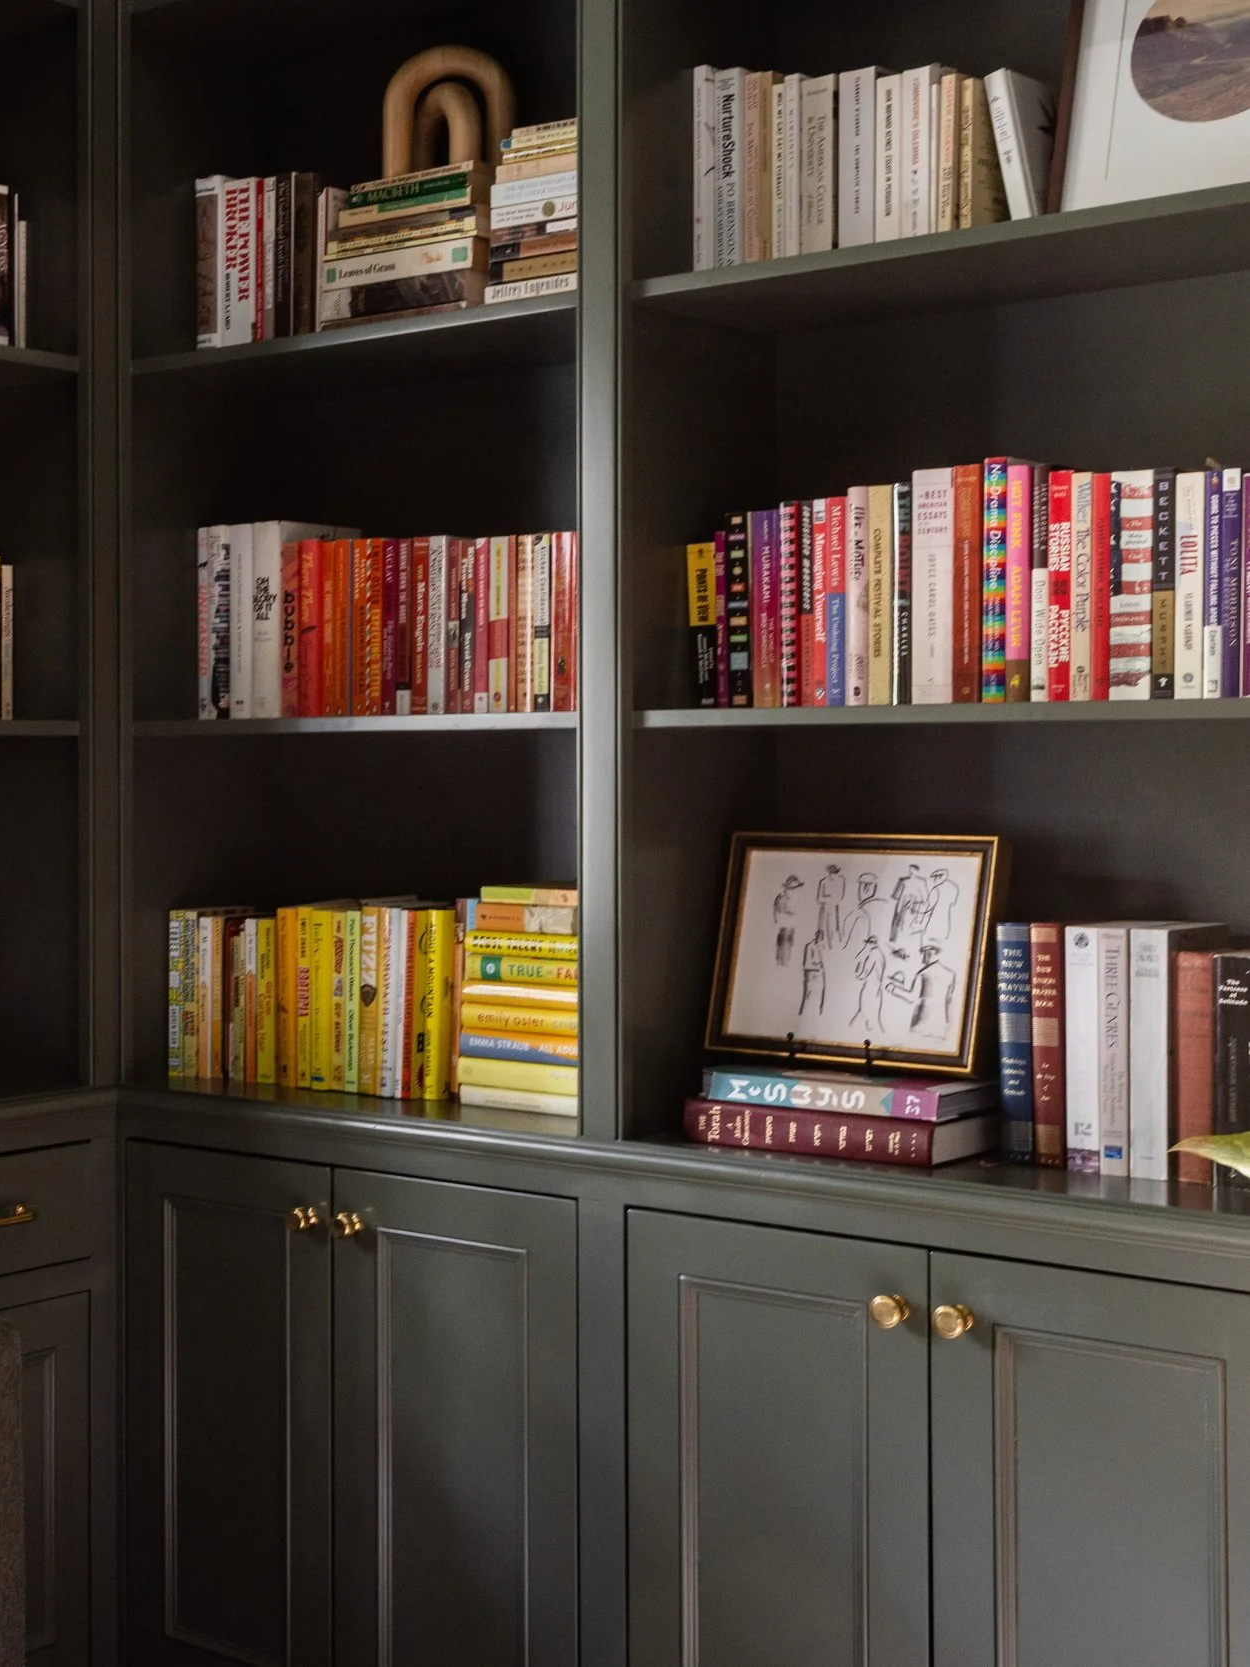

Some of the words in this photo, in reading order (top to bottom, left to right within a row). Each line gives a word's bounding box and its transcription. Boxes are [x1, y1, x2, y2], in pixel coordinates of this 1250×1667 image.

[775, 109, 784, 120] MY
[775, 121, 784, 136] CAT
[816, 114, 827, 131] THE
[884, 103, 894, 129] MAYNARD
[721, 92, 736, 179] NurtureShock
[775, 137, 784, 151] EAT
[806, 125, 817, 177] UNIVERSITY
[853, 143, 862, 155] THE
[884, 130, 894, 152] KEYNES
[911, 129, 921, 165] DILEMMA
[775, 152, 784, 162] MY
[815, 135, 828, 183] AMERICAN
[853, 157, 862, 186] COMPLETE
[884, 154, 894, 174] ESSAYS
[238, 186, 251, 226] THE
[367, 181, 420, 201] MACBETH
[815, 185, 828, 225] COLLEGE
[884, 183, 894, 217] PERSUASION
[225, 187, 238, 272] BROKER
[724, 198, 736, 256] BRONSON
[237, 230, 251, 302] POWER
[337, 265, 363, 279] Leaves
[373, 261, 397, 274] Grass
[491, 284, 524, 300] Jeffrey
[524, 276, 570, 294] Eugenides
[989, 463, 1006, 527] No-Drama
[1011, 479, 1023, 506] HOT
[1075, 482, 1091, 524] Walker
[1209, 494, 1220, 512] GOING
[802, 505, 812, 555] invisible
[830, 504, 843, 552] Michael
[1011, 511, 1023, 549] PINK
[1158, 480, 1170, 581] BECKETT
[1209, 513, 1220, 525] TO
[873, 528, 883, 575] COMPLETE
[1049, 521, 1061, 571] STORIES
[1059, 521, 1071, 571] RUSSIAN
[1075, 528, 1091, 548] The
[1208, 526, 1220, 549] PIECES
[540, 545, 550, 575] Kitchen
[813, 532, 827, 591] Managing
[830, 553, 842, 587] Lewis
[898, 533, 911, 592] POINT
[927, 554, 937, 579] JOYCE
[988, 529, 1007, 591] Discipline
[1075, 553, 1091, 589] Color
[1179, 534, 1199, 576] LOLITA
[1208, 549, 1220, 579] WITHOUT
[1228, 538, 1239, 571] TONI
[372, 576, 381, 605] OSTER
[461, 557, 469, 592] Flower
[696, 567, 709, 593] POINTS
[761, 545, 772, 604] MURAKAMI
[802, 557, 812, 610] monsters
[1010, 564, 1022, 606] ADAM
[1035, 579, 1047, 600] Door
[461, 592, 469, 619] Moon
[539, 577, 549, 626] Confidential
[831, 598, 840, 614] The
[873, 577, 883, 619] FESTIVAL
[927, 582, 937, 608] CAROL
[1184, 592, 1195, 622] VLADIMIR
[1208, 579, 1219, 605] FALLING
[413, 580, 426, 652] Marx-Engels
[813, 591, 827, 644] Yourself
[1034, 608, 1047, 636] Wide
[1071, 592, 1091, 633] Purple
[1208, 606, 1219, 625] APART
[1227, 576, 1239, 646] MORRISON
[371, 607, 381, 660] EXPECTING
[829, 615, 840, 652] Undoing
[873, 622, 883, 659] STORIES
[901, 611, 910, 656] CHARLES
[1010, 609, 1022, 648] LEVIN
[1048, 604, 1060, 668] РАССКАЗЫ
[1059, 609, 1070, 663] РУССКИЕ
[1158, 598, 1169, 668] MURPHY
[1184, 623, 1195, 651] NABOKOV
[464, 631, 473, 660] David
[760, 629, 768, 669] CHRONICLE
[1033, 637, 1046, 666] Open
[371, 662, 381, 697] BETTER
[463, 660, 472, 691] Grann
[828, 652, 839, 684] Project
[347, 917, 355, 937] Four
[428, 923, 437, 954] ABOUT
[347, 938, 356, 976] Thousand
[361, 913, 377, 986] FUZZ
[1000, 959, 1025, 969] NEW
[1001, 947, 1024, 958] THE
[1036, 953, 1051, 961] THE
[507, 963, 544, 978] TRUE
[997, 971, 1030, 980] UNION
[1103, 944, 1122, 991] THREE
[425, 966, 437, 1018] MOUNTAIN
[997, 982, 1032, 992] PRAYER
[998, 993, 1029, 1004] BOOK
[258, 992, 267, 1030] Curious
[346, 1009, 355, 1031] Oliver
[477, 1011, 510, 1027] emily
[512, 1016, 545, 1028] oster
[1102, 991, 1123, 1049] GENRES
[258, 1031, 267, 1052] Hair
[368, 1037, 376, 1064] MARY
[380, 1022, 391, 1053] TEST
[468, 1036, 495, 1047] EMMA
[495, 1039, 530, 1050] STRAUB
[537, 1043, 554, 1053] ALL
[1228, 1035, 1238, 1085] JONATHAN
[904, 1093, 922, 1116] 37
[1228, 1085, 1238, 1123] LETHEM
[697, 1114, 708, 1130] THE
[707, 1105, 722, 1142] Torah
[733, 1115, 743, 1139] Modern
[741, 1110, 751, 1146] Commentary
